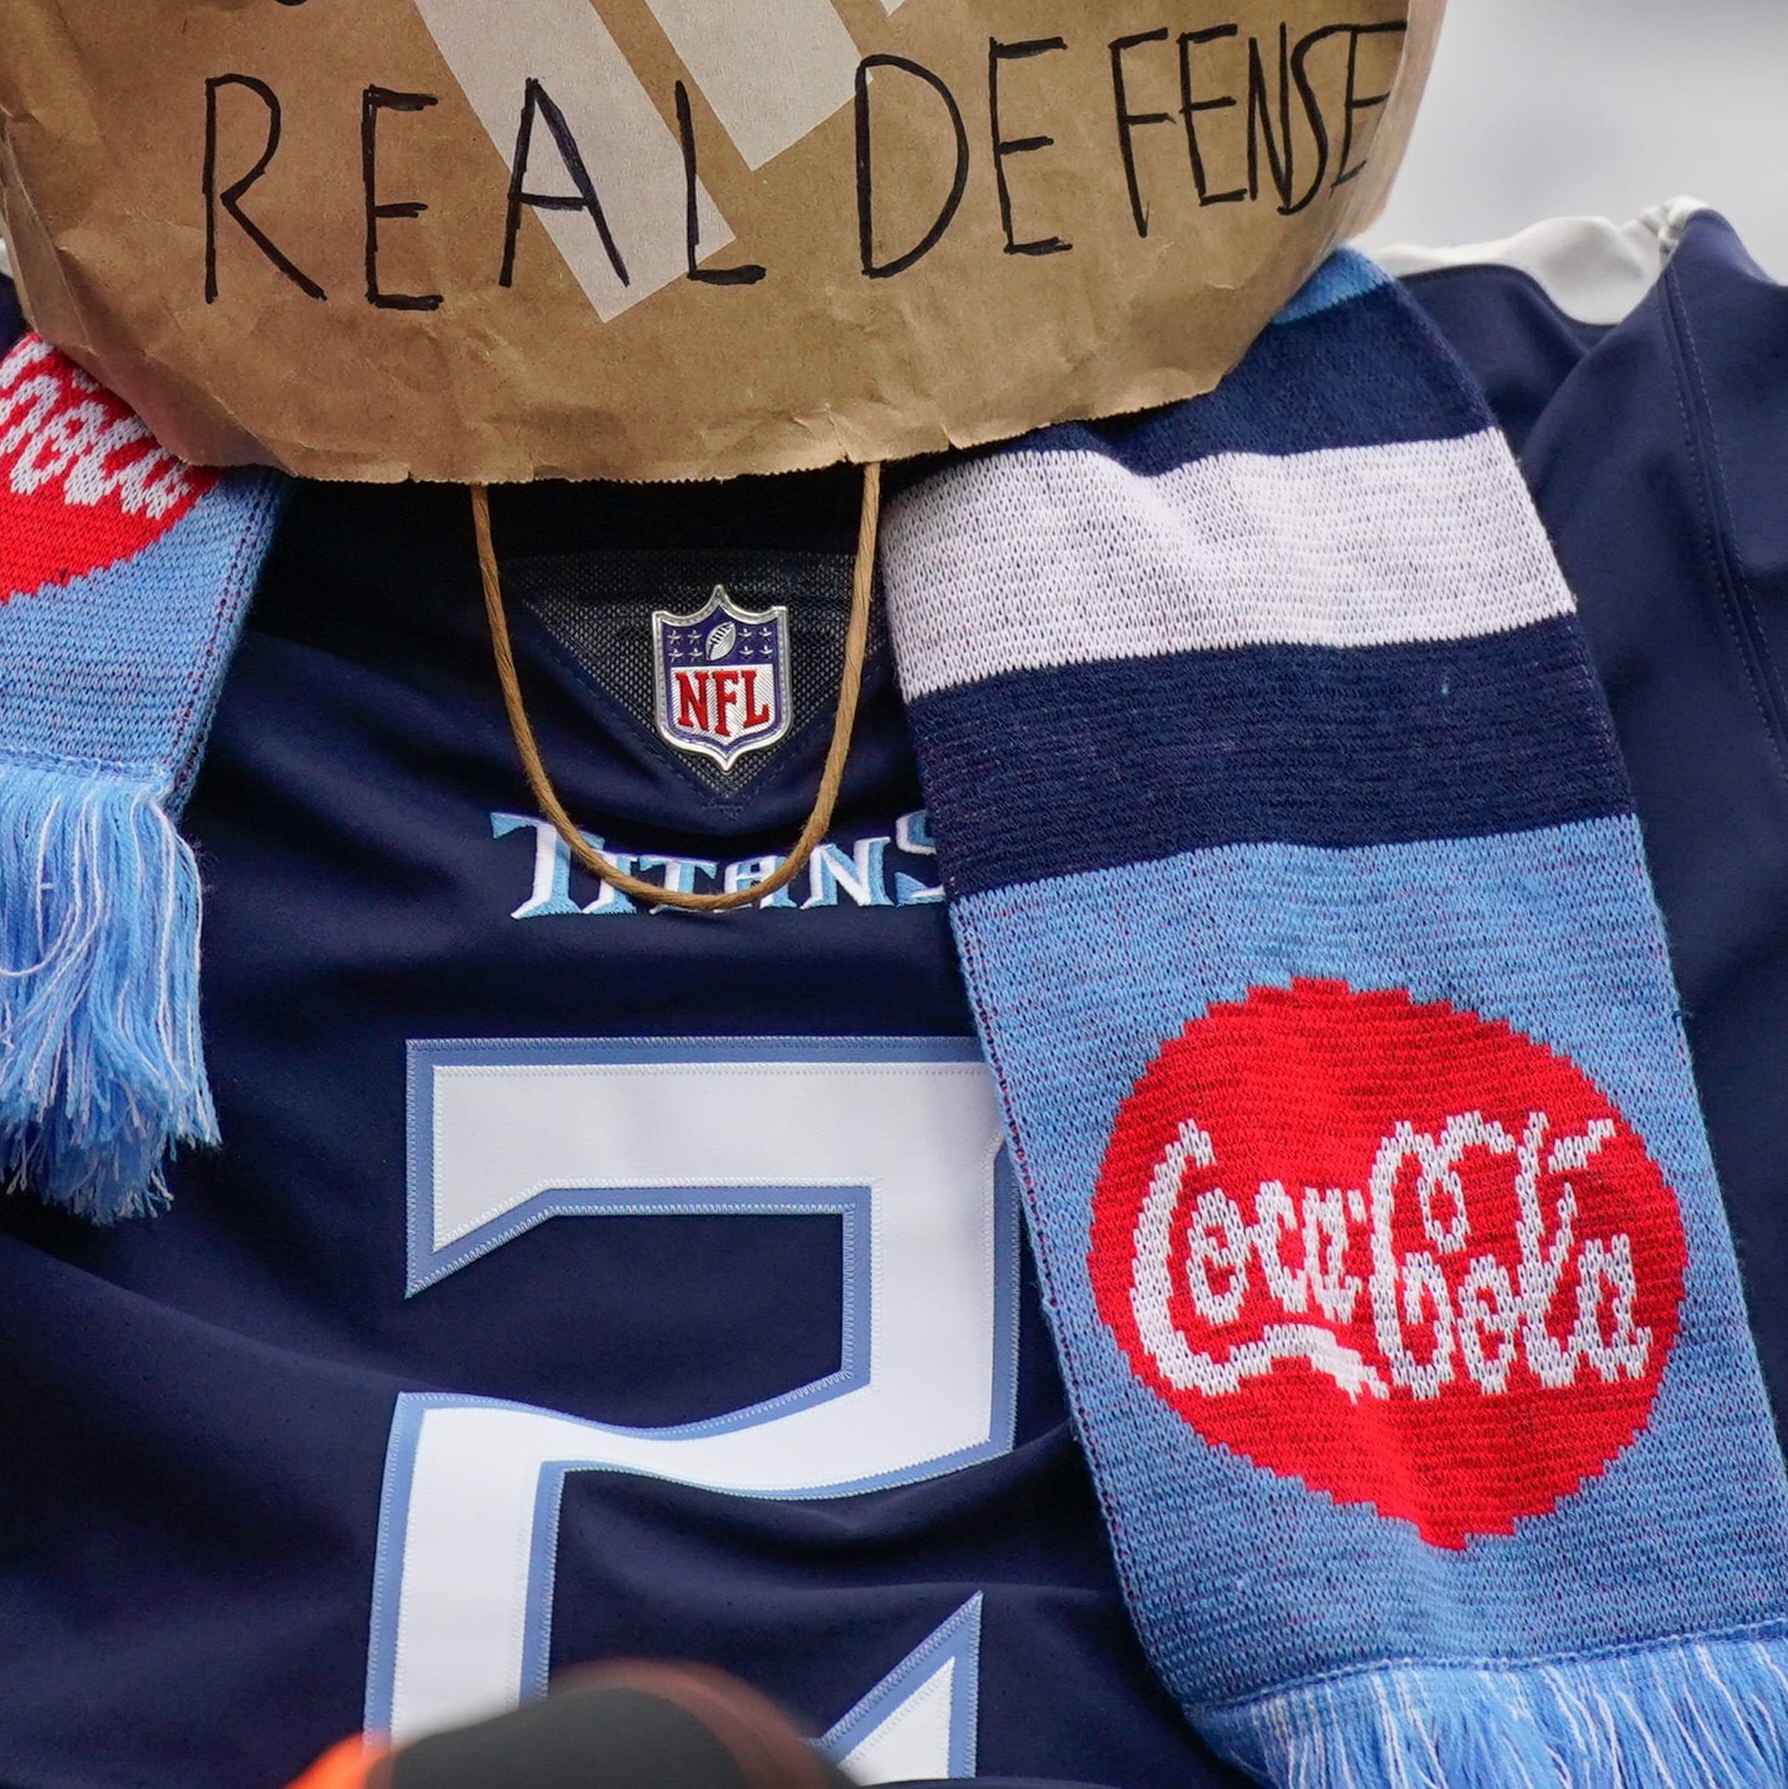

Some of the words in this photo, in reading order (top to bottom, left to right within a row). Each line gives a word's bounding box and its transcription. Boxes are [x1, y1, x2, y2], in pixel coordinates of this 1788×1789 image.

[202, 73, 767, 311] REAL
[854, 21, 1410, 283] DEFENSE
[675, 669, 771, 737] NFL
[491, 809, 946, 922] TITANS
[1128, 1109, 1653, 1399] Coca-Cola
